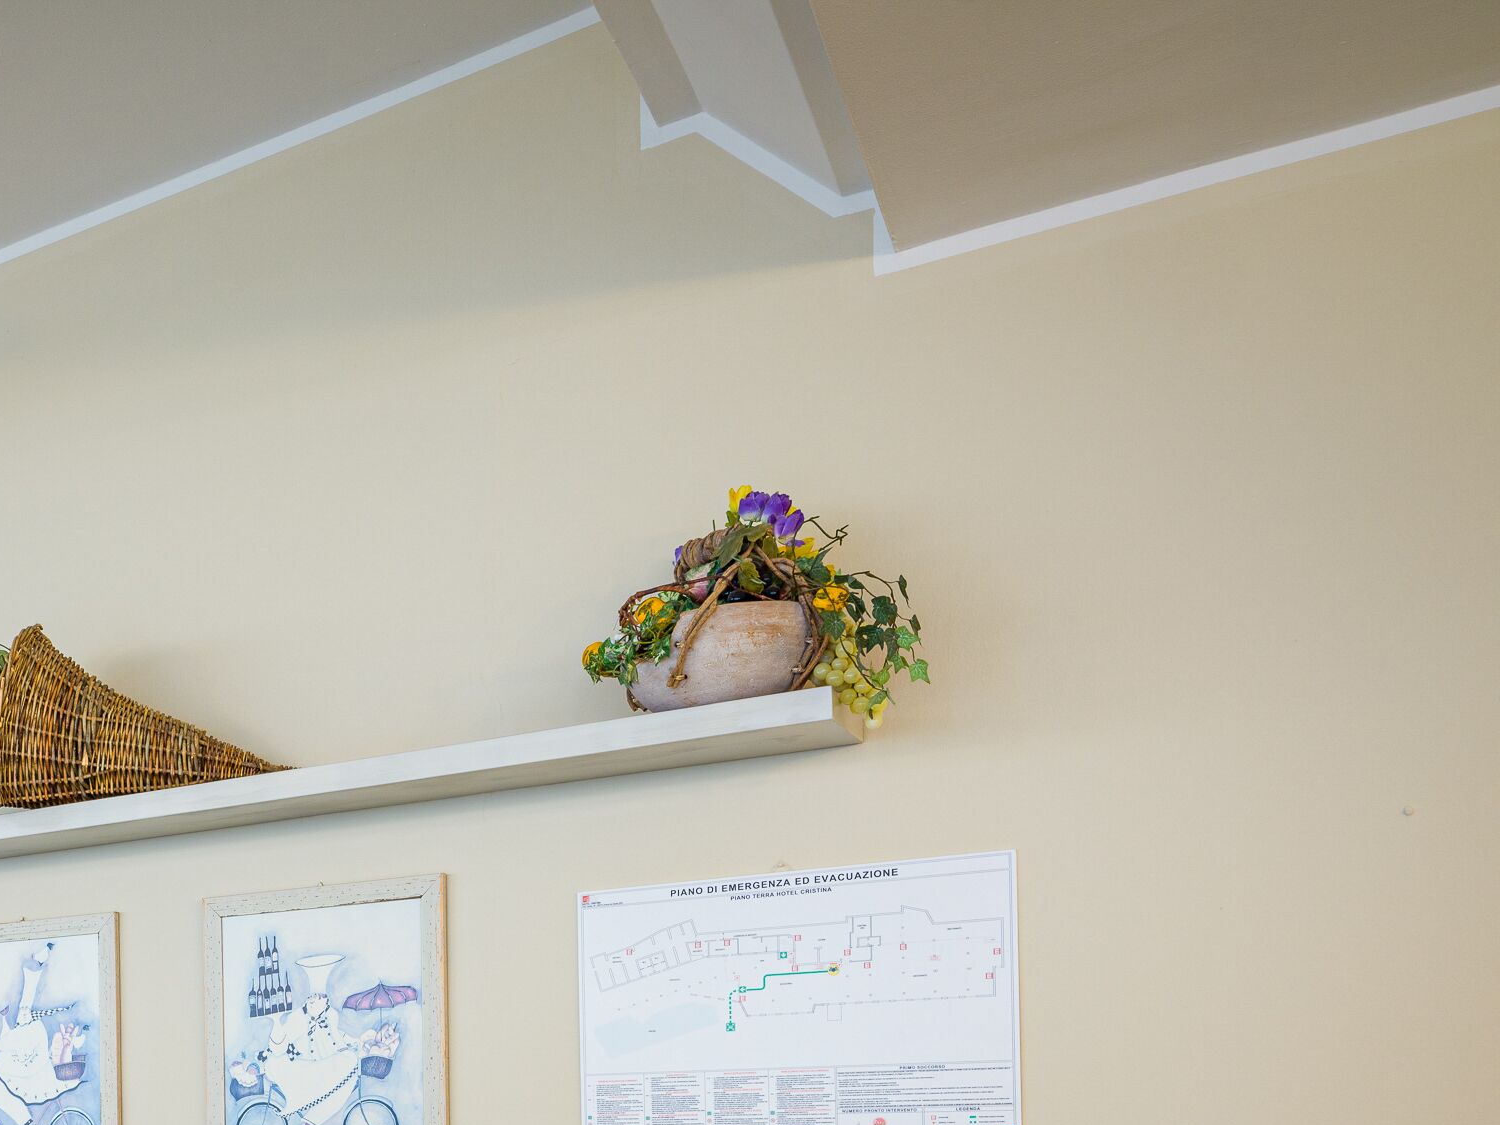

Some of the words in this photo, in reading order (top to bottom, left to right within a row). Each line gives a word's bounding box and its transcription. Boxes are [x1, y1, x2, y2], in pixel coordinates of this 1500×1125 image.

[670, 887, 703, 897] PIANO
[707, 886, 718, 894] DI
[721, 880, 790, 893] EMERGENZA
[795, 877, 810, 885] ED
[814, 868, 899, 884] EVACUAZIONE
[801, 887, 832, 896] CRISTINA
